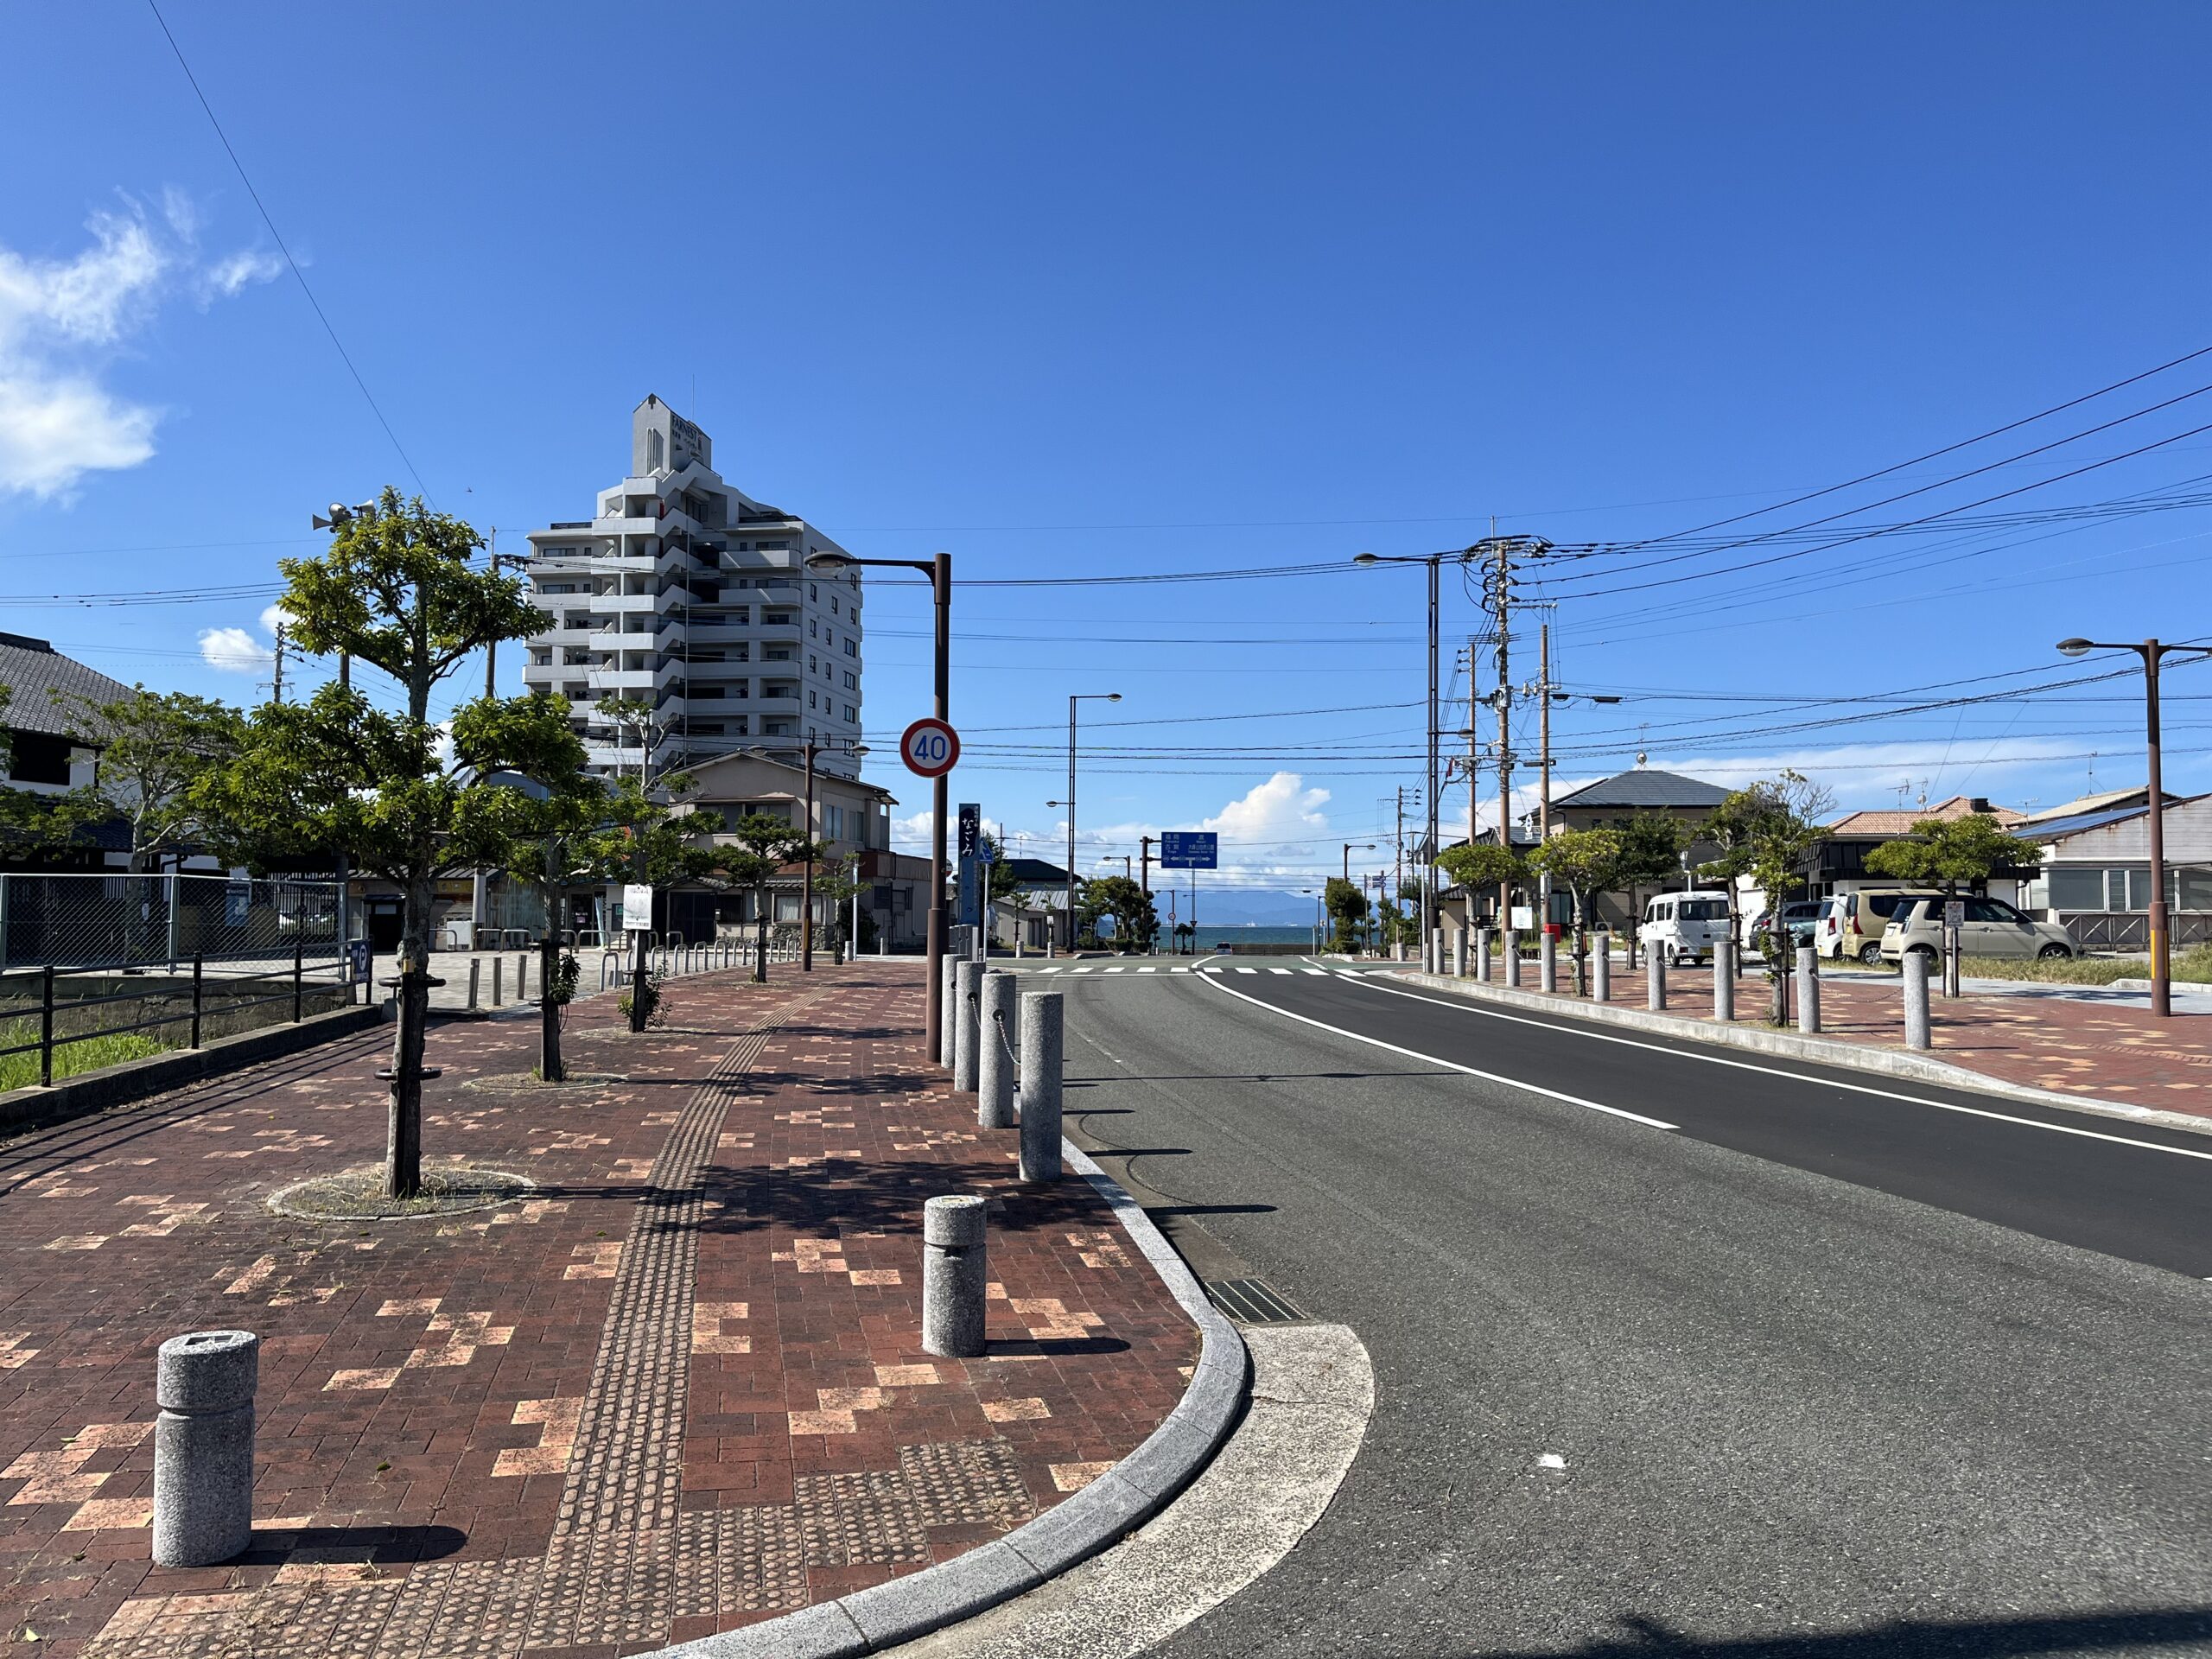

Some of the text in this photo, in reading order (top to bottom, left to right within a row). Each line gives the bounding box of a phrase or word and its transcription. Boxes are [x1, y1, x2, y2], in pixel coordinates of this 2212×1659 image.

[914, 734, 946, 761] 40
[961, 817, 974, 857] なごみ
